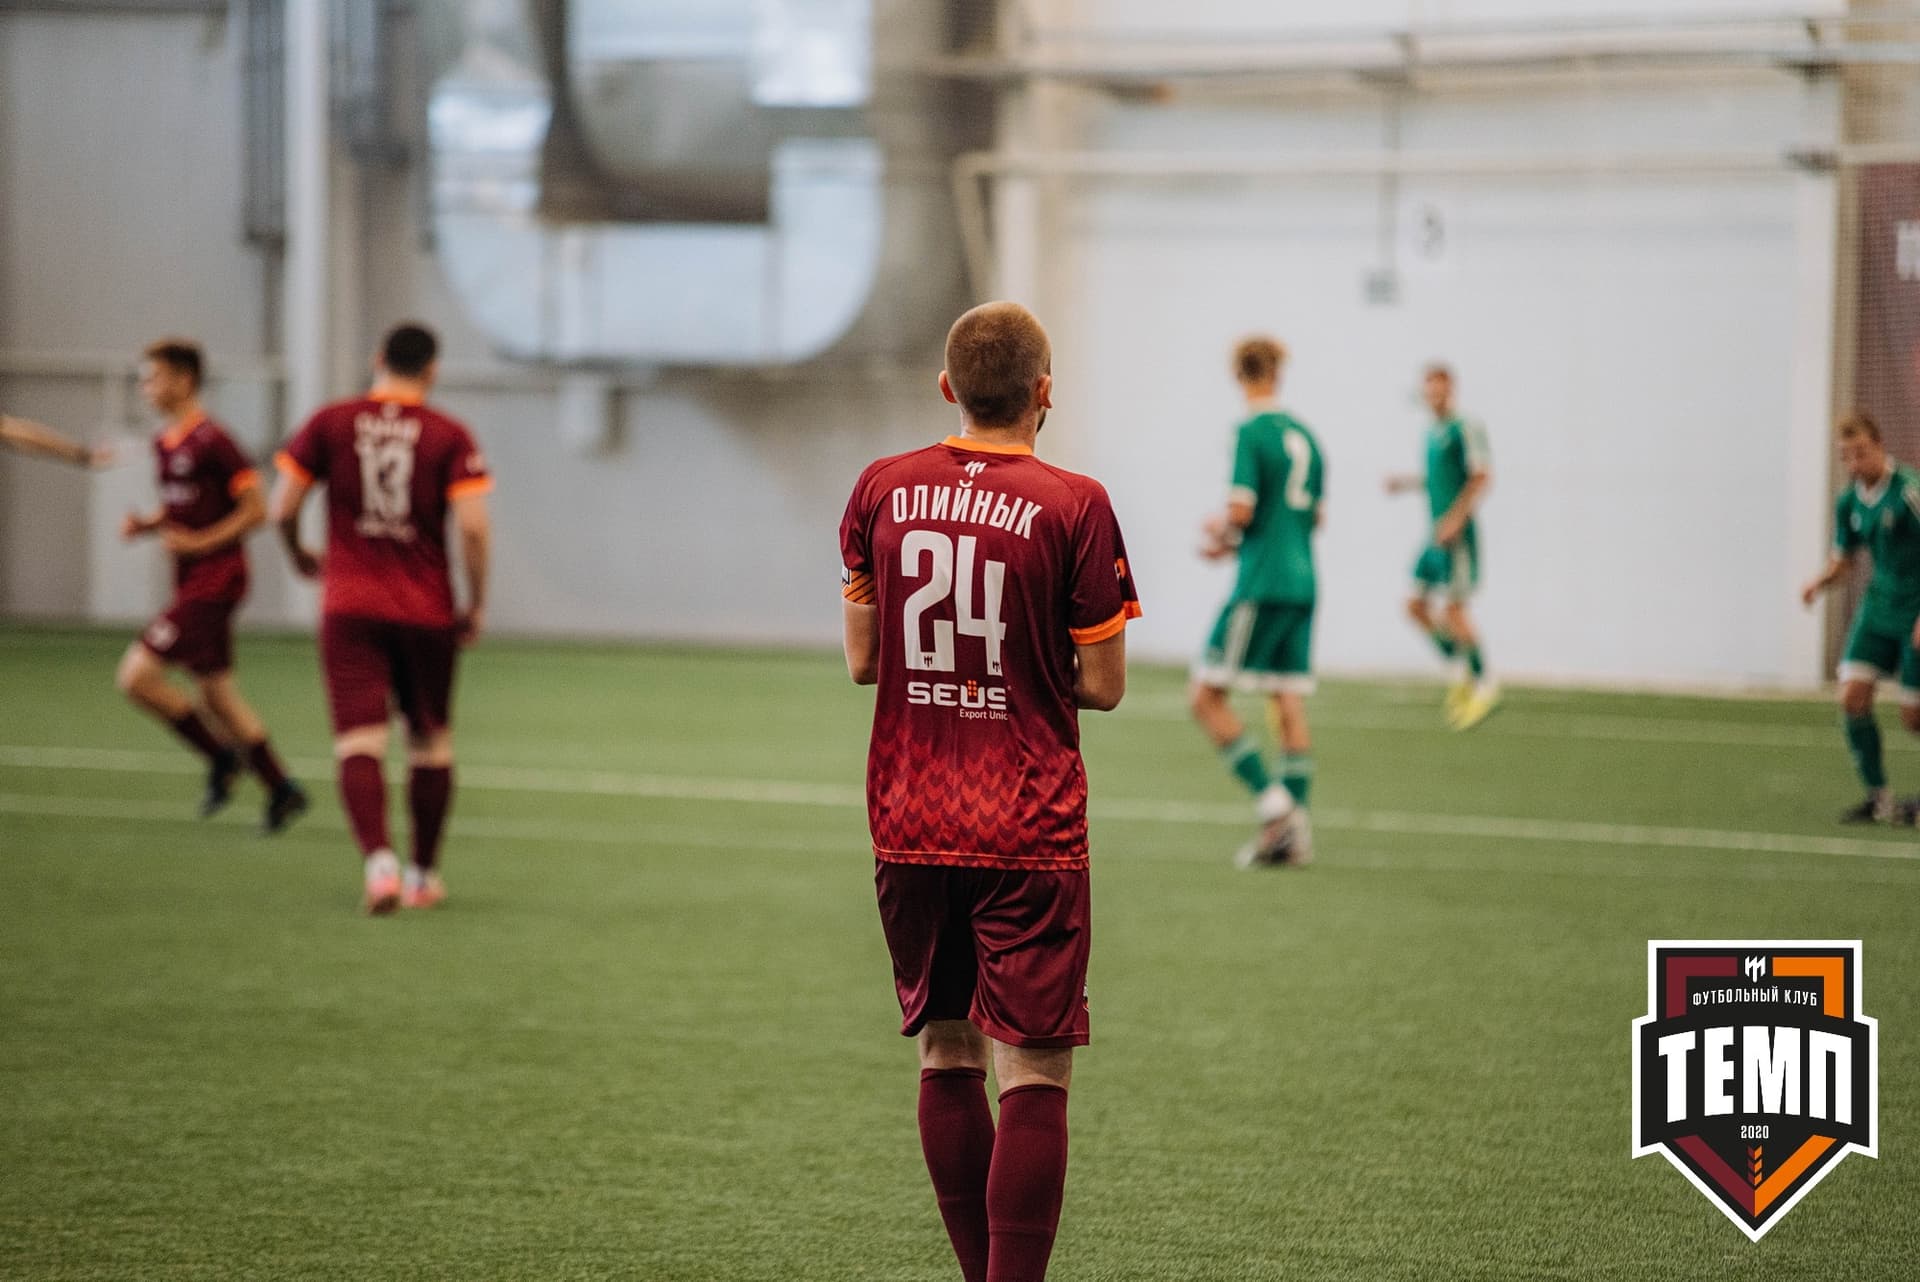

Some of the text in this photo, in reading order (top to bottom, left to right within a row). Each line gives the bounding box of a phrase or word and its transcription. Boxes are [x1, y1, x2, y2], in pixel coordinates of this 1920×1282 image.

[358, 441, 415, 520] 13
[1282, 427, 1314, 511] 2
[892, 479, 1042, 540] ОЛИЙНЫК
[900, 530, 1006, 677] 24
[960, 709, 988, 720] Export
